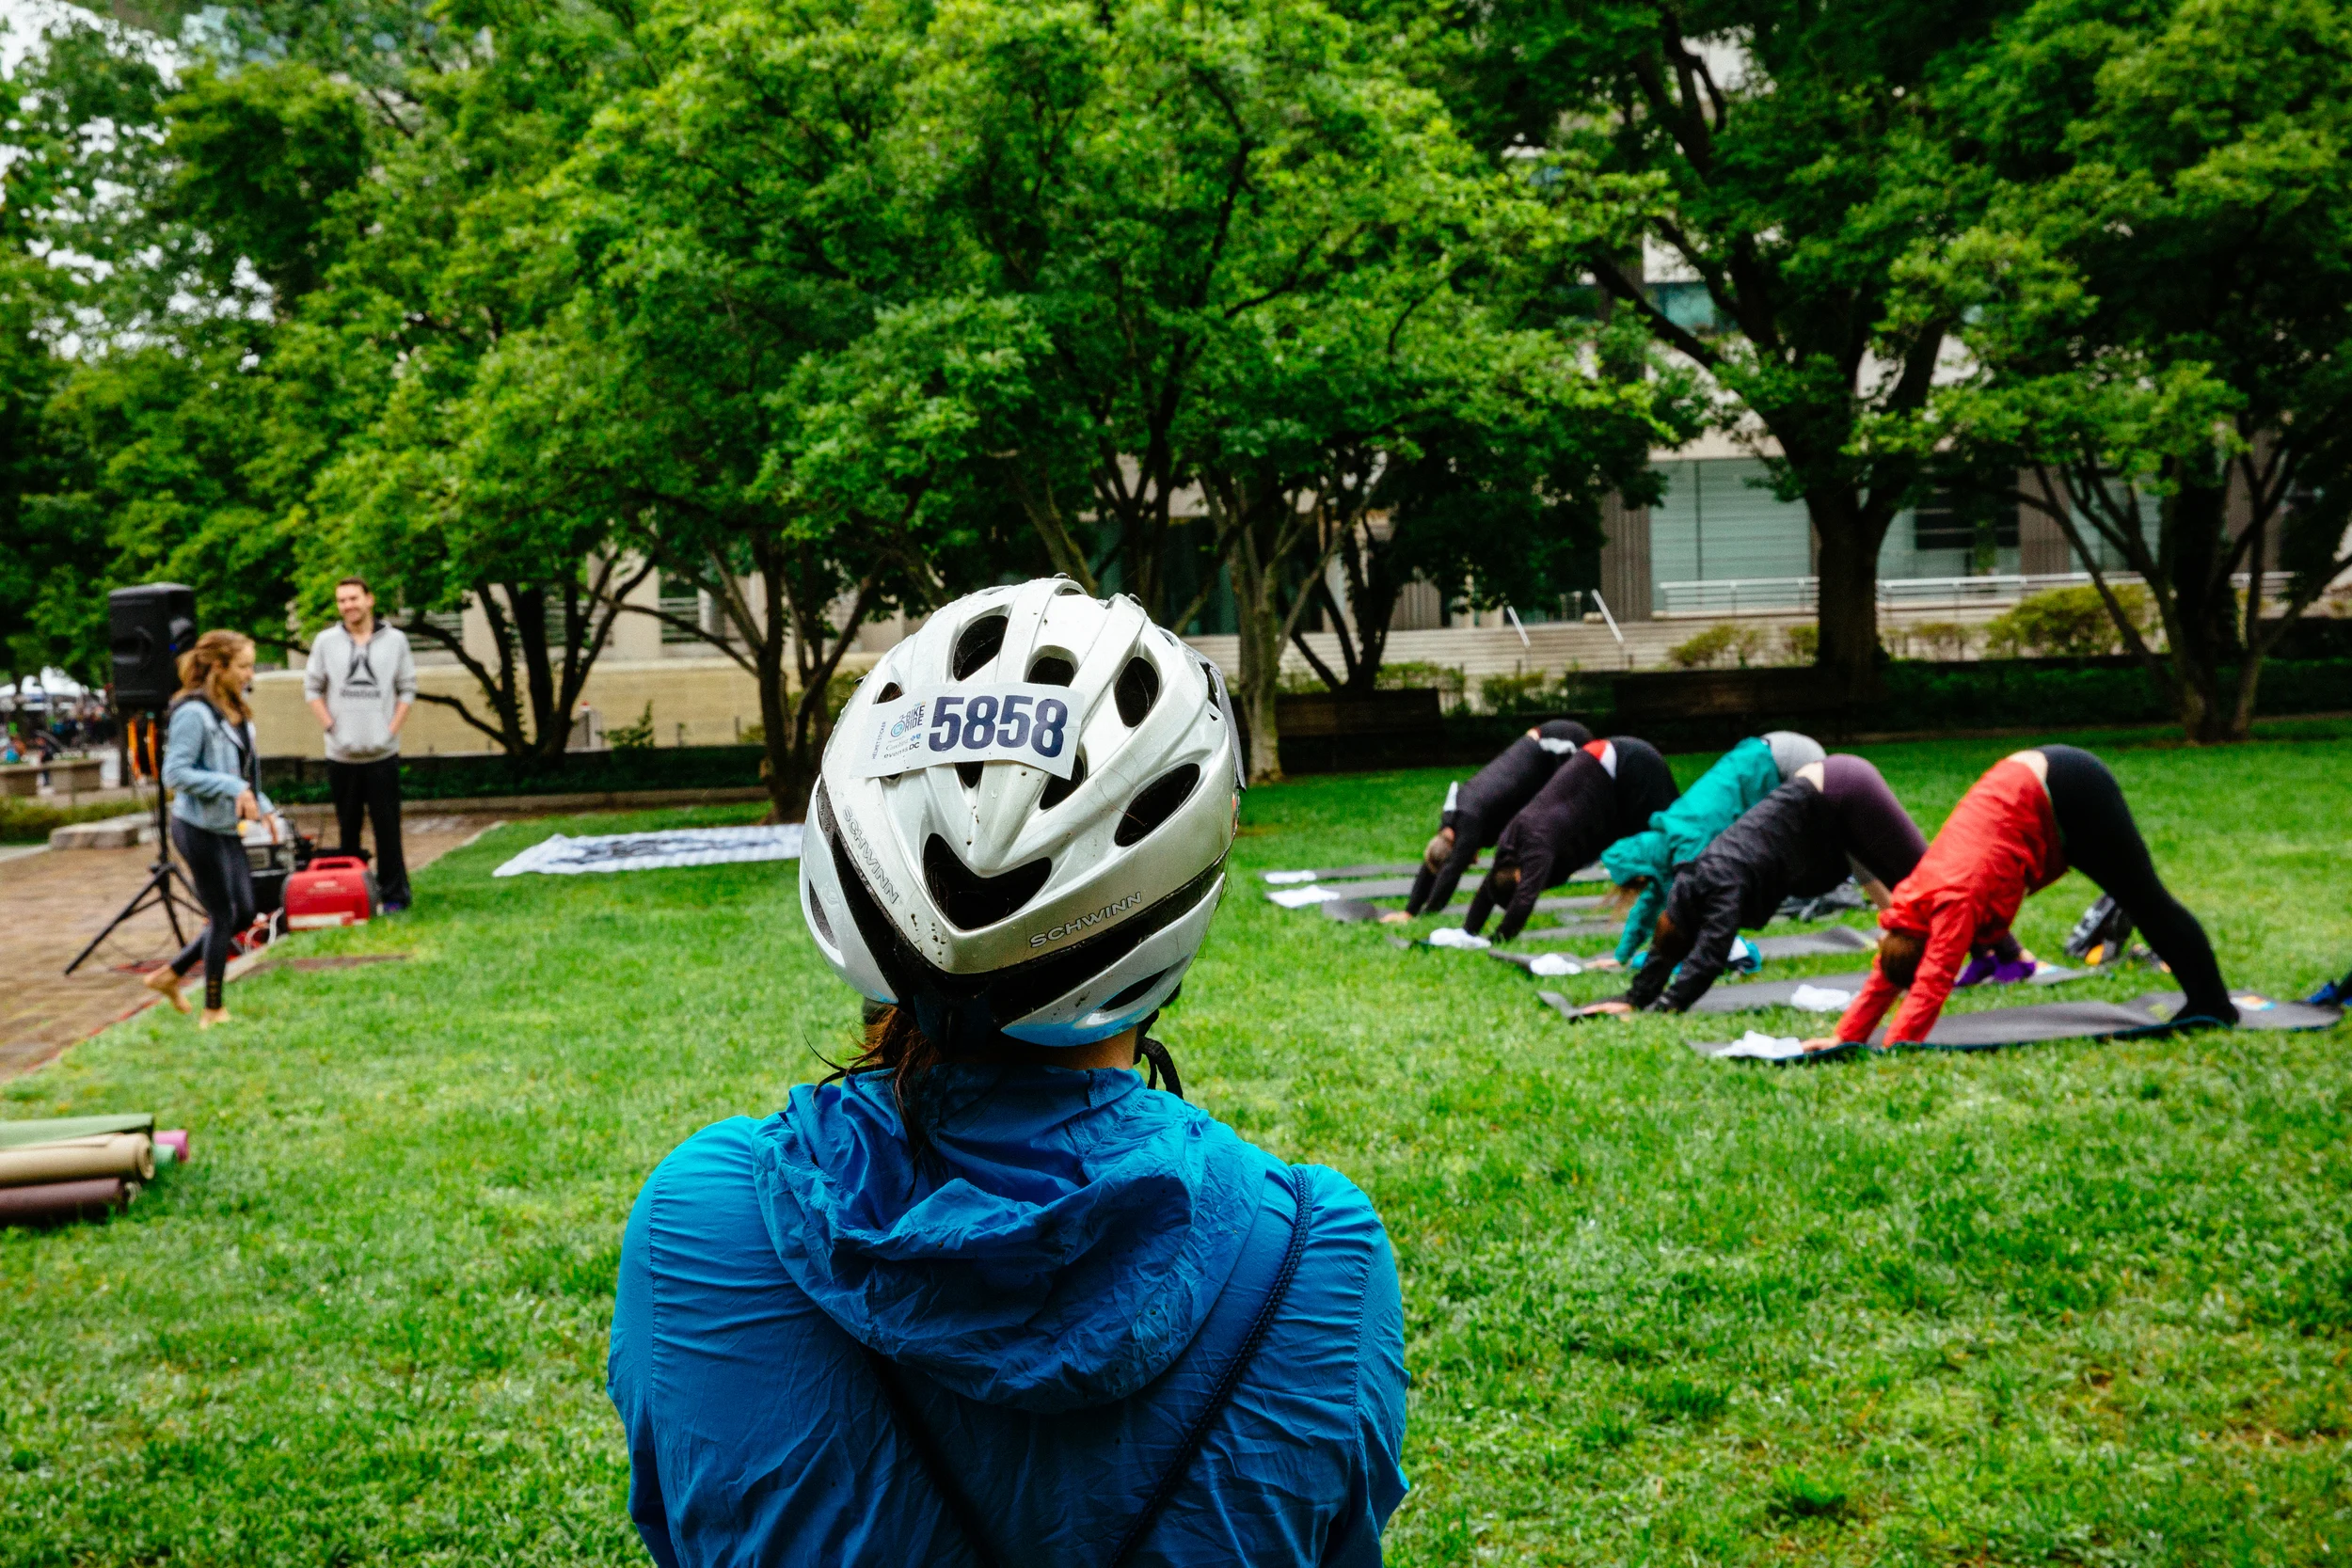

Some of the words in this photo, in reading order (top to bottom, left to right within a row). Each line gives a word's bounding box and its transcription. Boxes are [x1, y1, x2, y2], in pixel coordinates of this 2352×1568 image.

[877, 721, 886, 741] STICKER
[904, 716, 924, 732] RIDE
[906, 705, 926, 722] BIKE
[929, 695, 1069, 758] 5858
[842, 805, 899, 904] SCHWINN
[1029, 891, 1142, 948] SCHWINN
